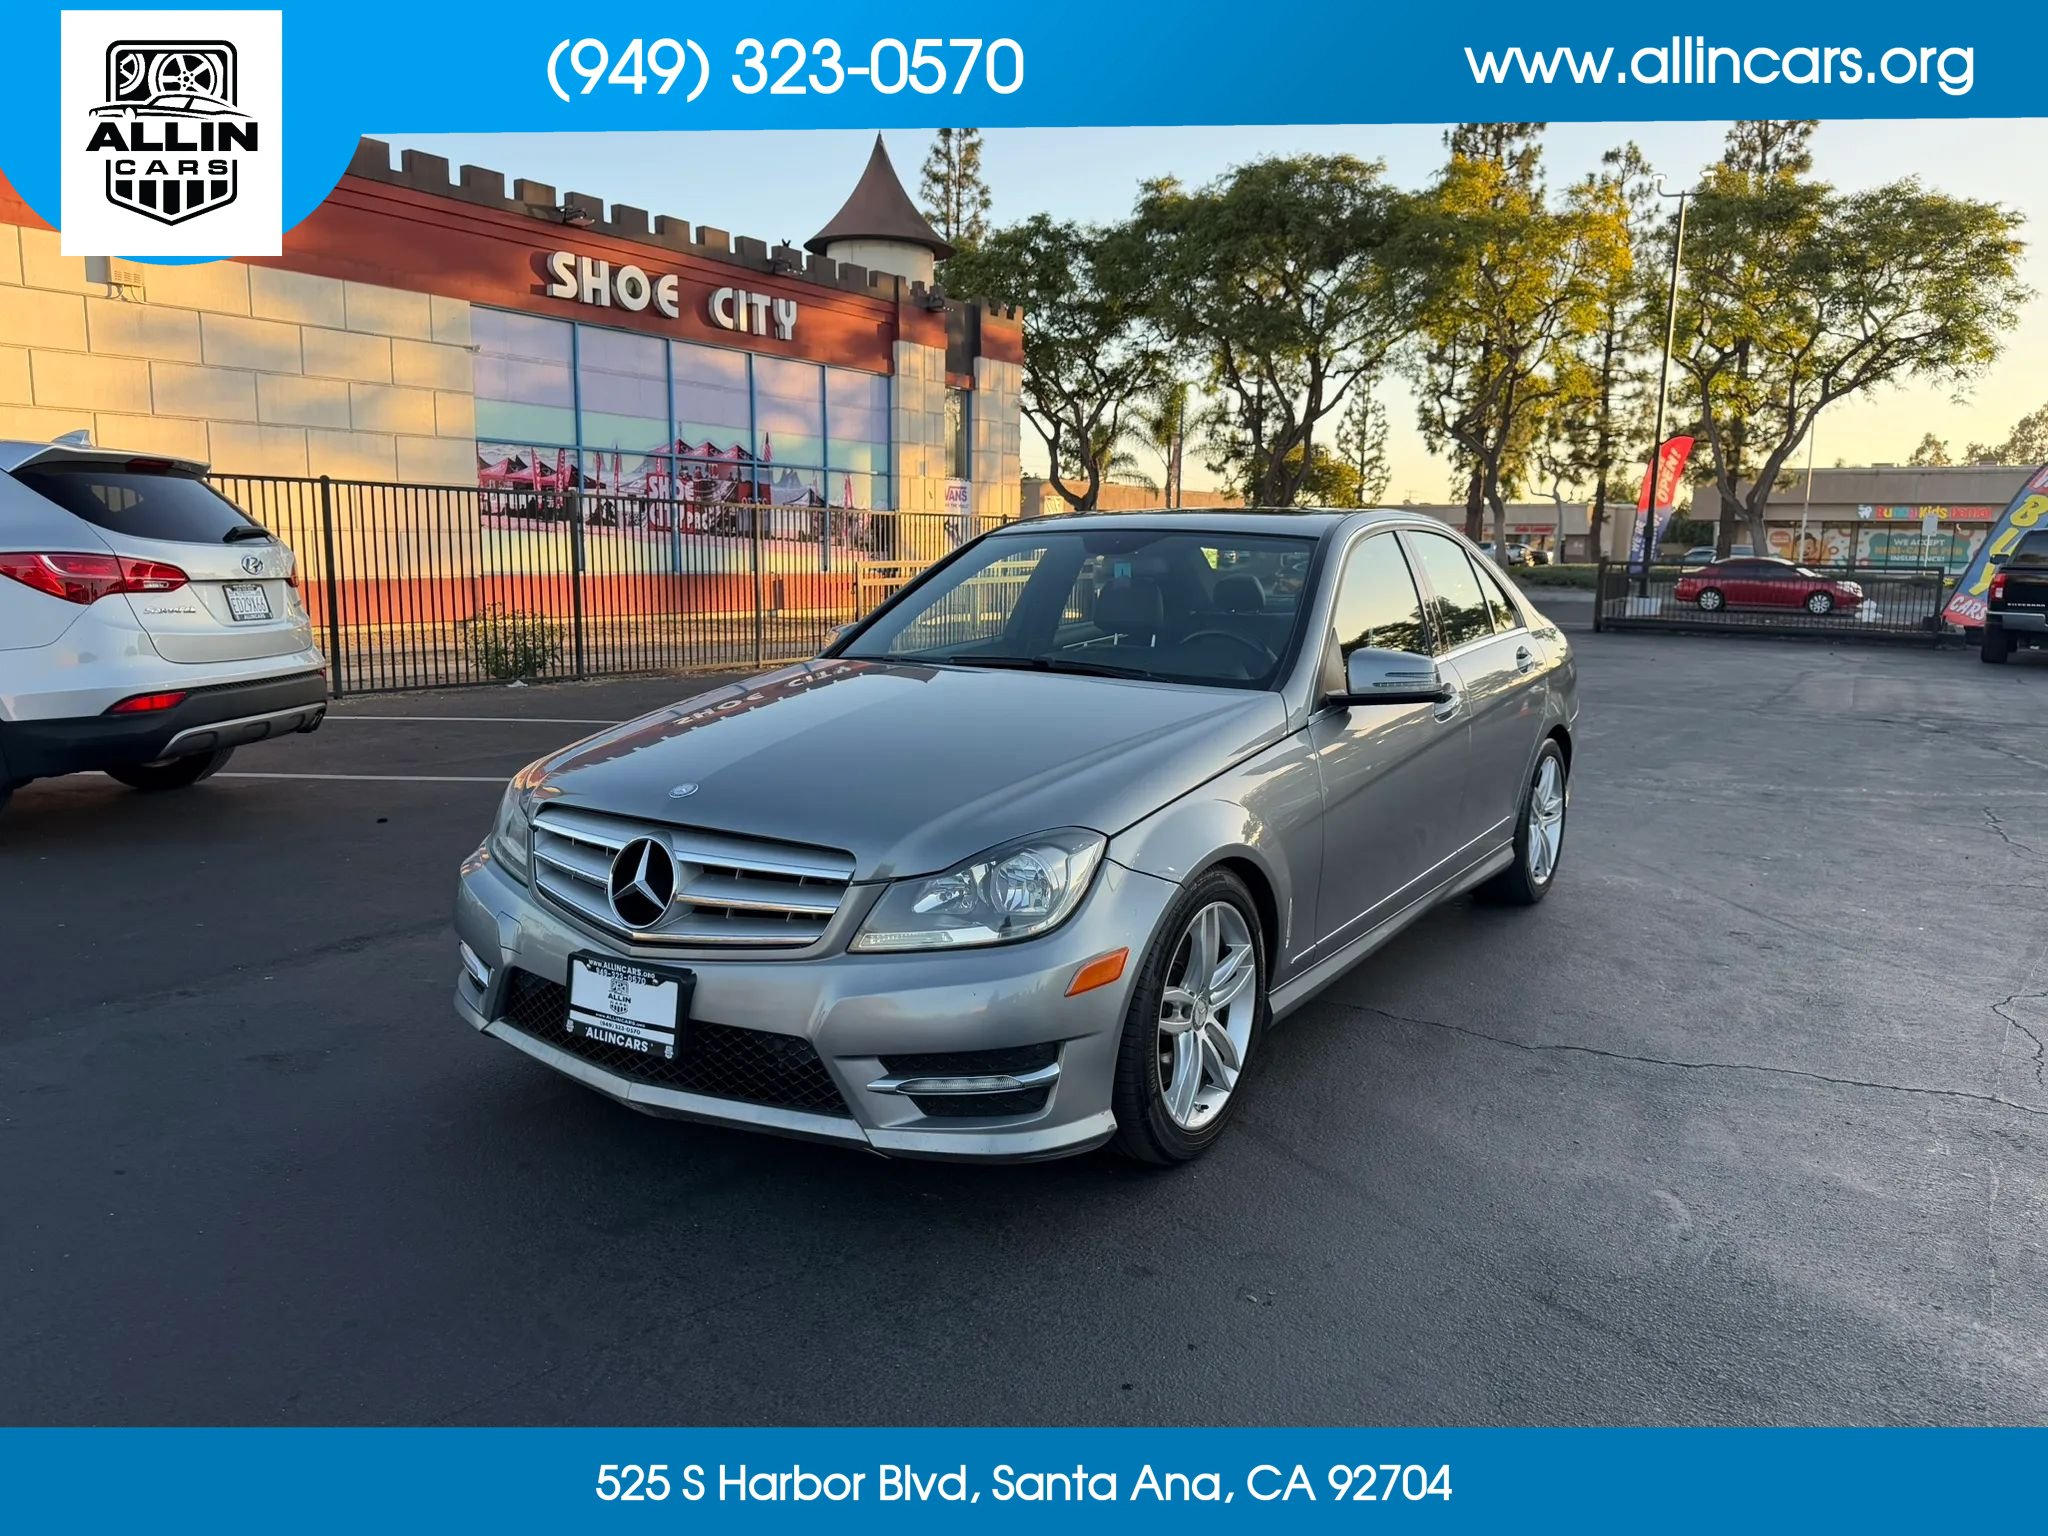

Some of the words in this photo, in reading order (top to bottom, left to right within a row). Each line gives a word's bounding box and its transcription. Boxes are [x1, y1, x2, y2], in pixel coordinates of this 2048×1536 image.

[547, 251, 679, 319] SHOE
[708, 287, 797, 340] CITY
[1657, 447, 1682, 503] OPEN!
[945, 486, 967, 502] VANS
[1949, 596, 1987, 621] CARS
[607, 993, 632, 1004] ALLIN
[585, 1026, 649, 1052] ALLINCARS
